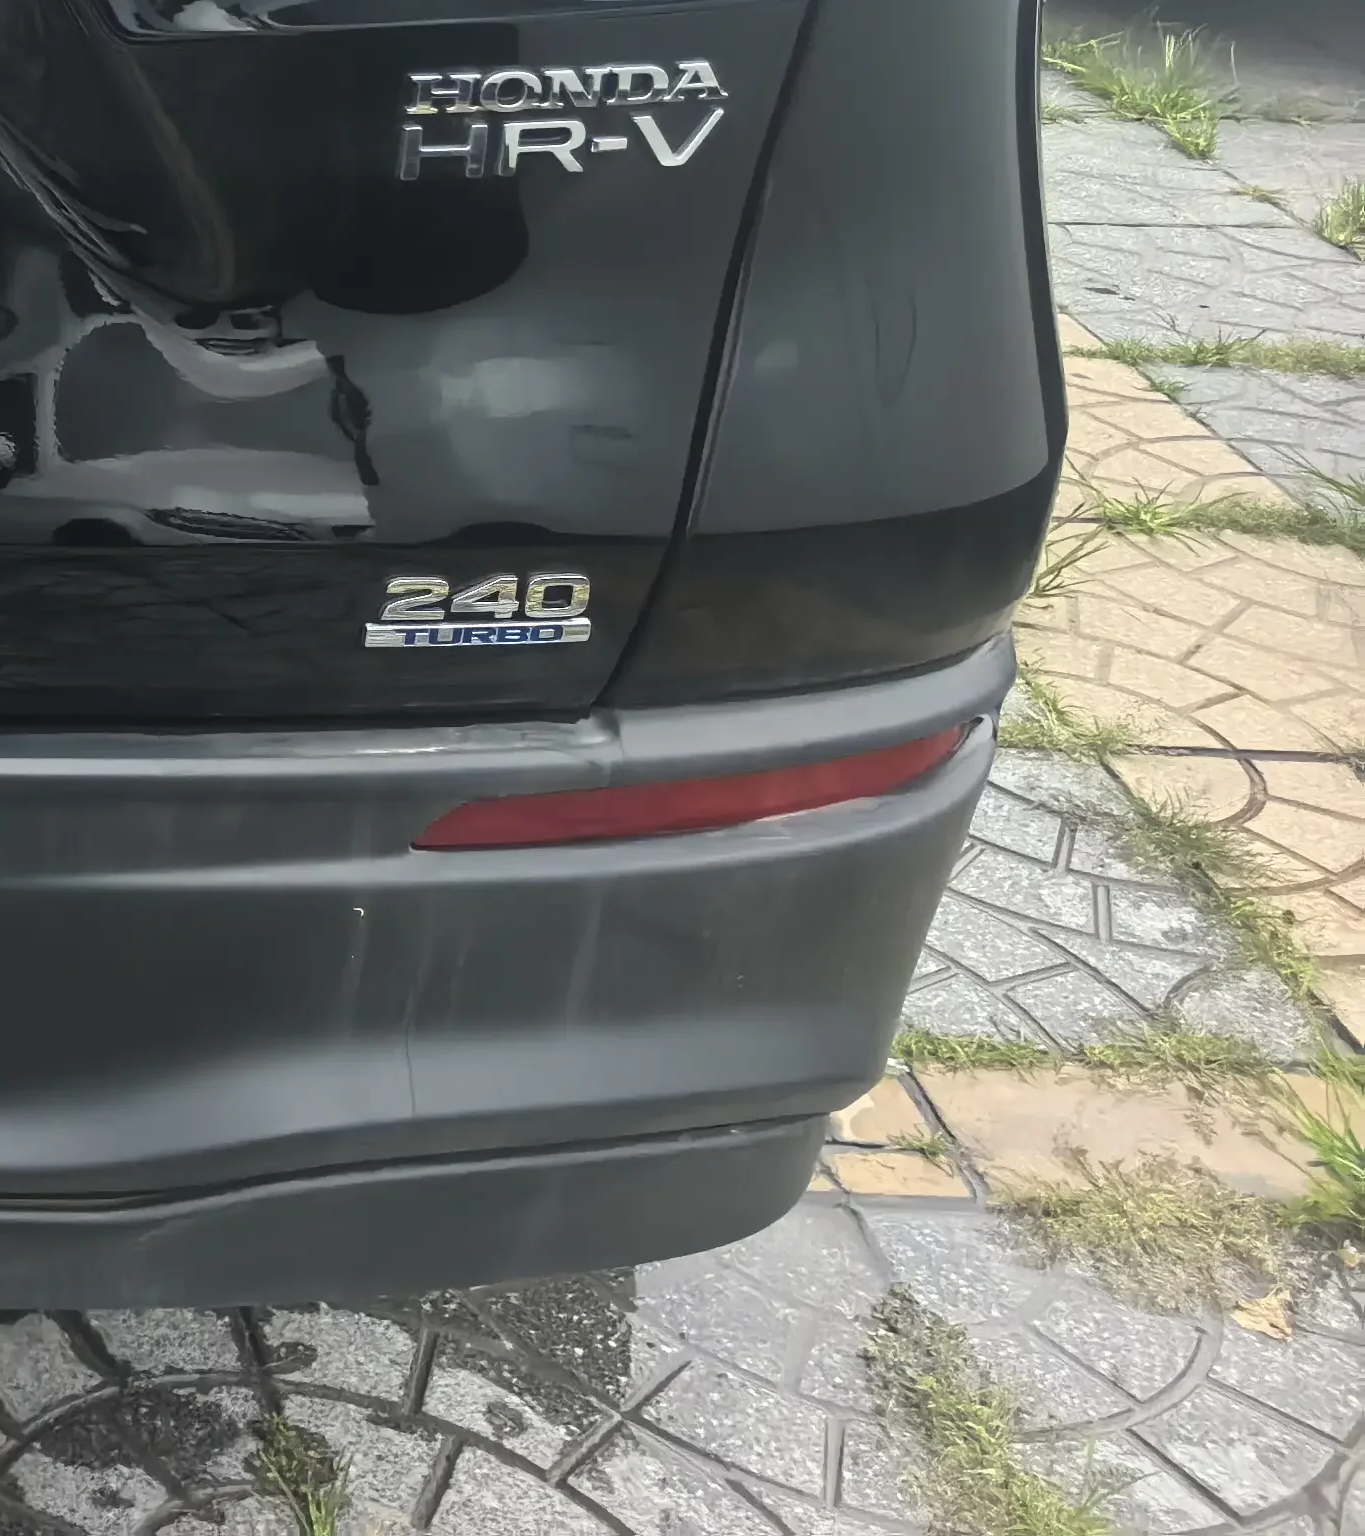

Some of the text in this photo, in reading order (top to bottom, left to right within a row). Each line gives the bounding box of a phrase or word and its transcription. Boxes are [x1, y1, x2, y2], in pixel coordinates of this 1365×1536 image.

[405, 58, 730, 115] HONDA
[397, 106, 726, 182] HR-V
[378, 572, 591, 621] 240
[395, 624, 564, 647] TURBO
